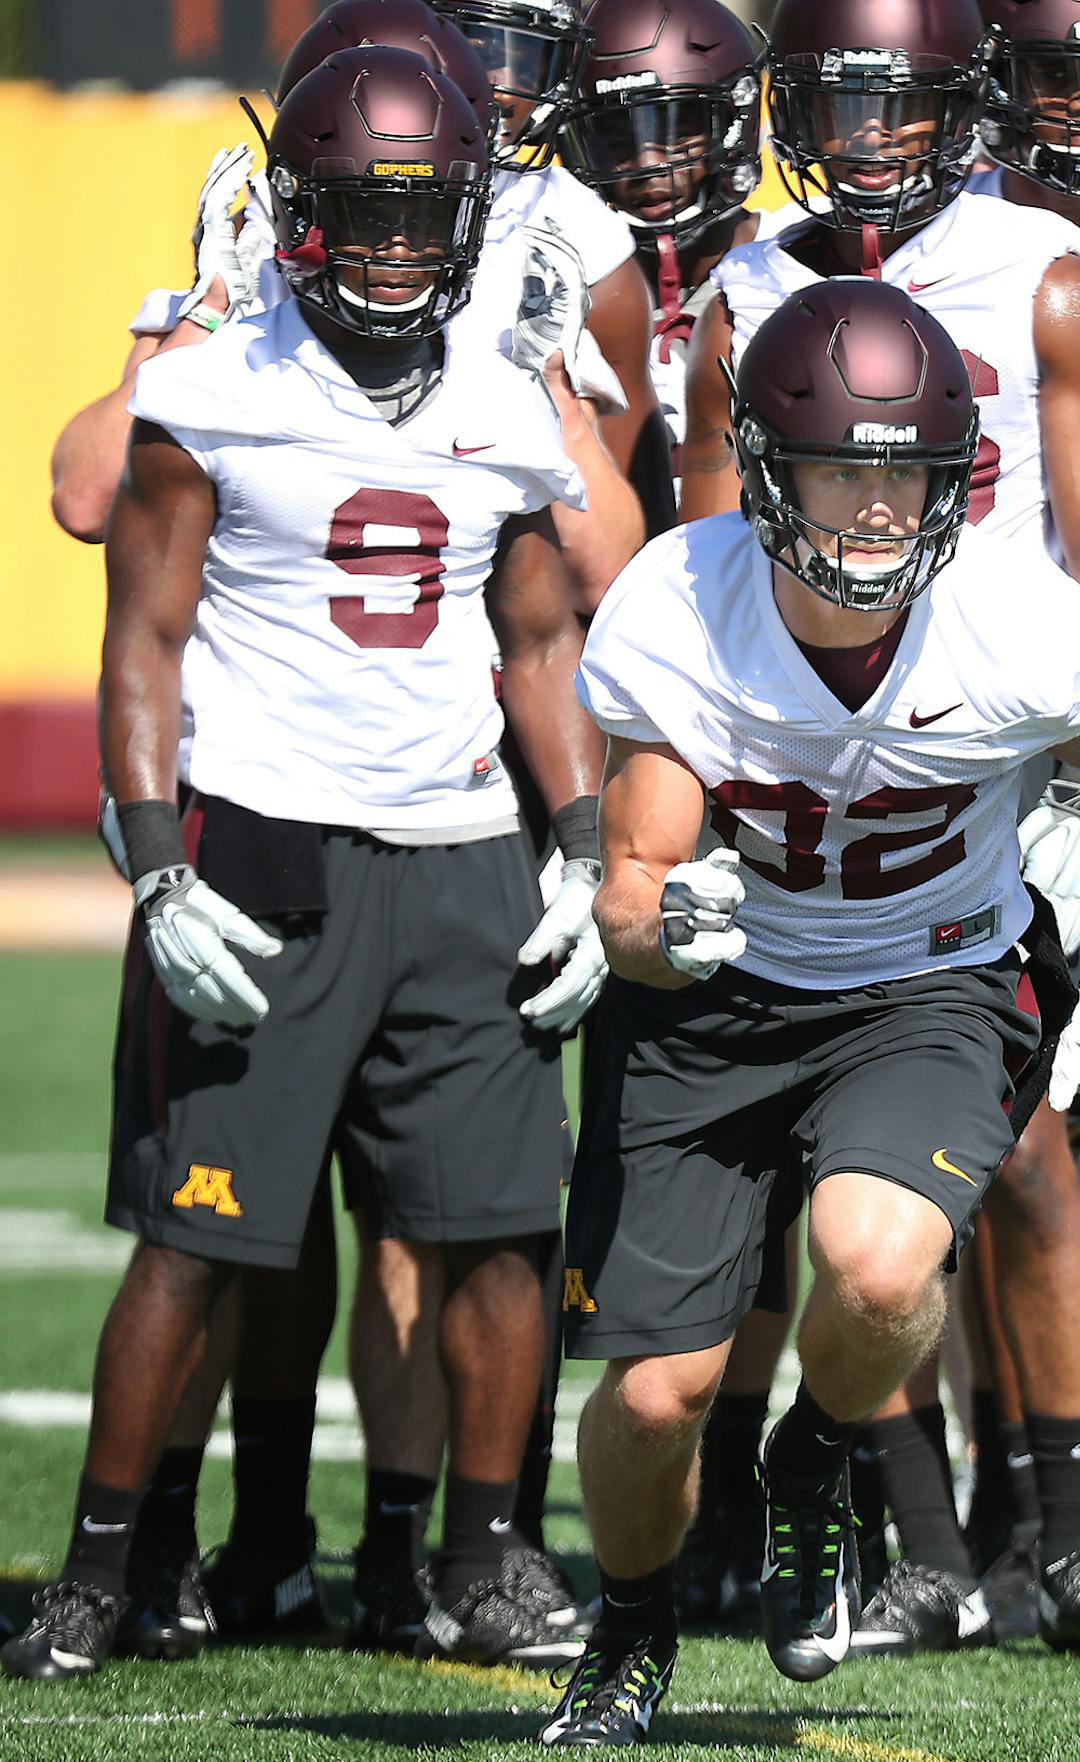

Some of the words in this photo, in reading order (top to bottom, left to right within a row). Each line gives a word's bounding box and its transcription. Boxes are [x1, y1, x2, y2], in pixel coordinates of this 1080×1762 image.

[373, 163, 435, 176] GOPHERS
[852, 424, 917, 443] Riddell
[325, 486, 450, 649] 9
[851, 583, 885, 593] Riddell
[172, 1163, 244, 1217] M
[562, 1267, 598, 1313] M
